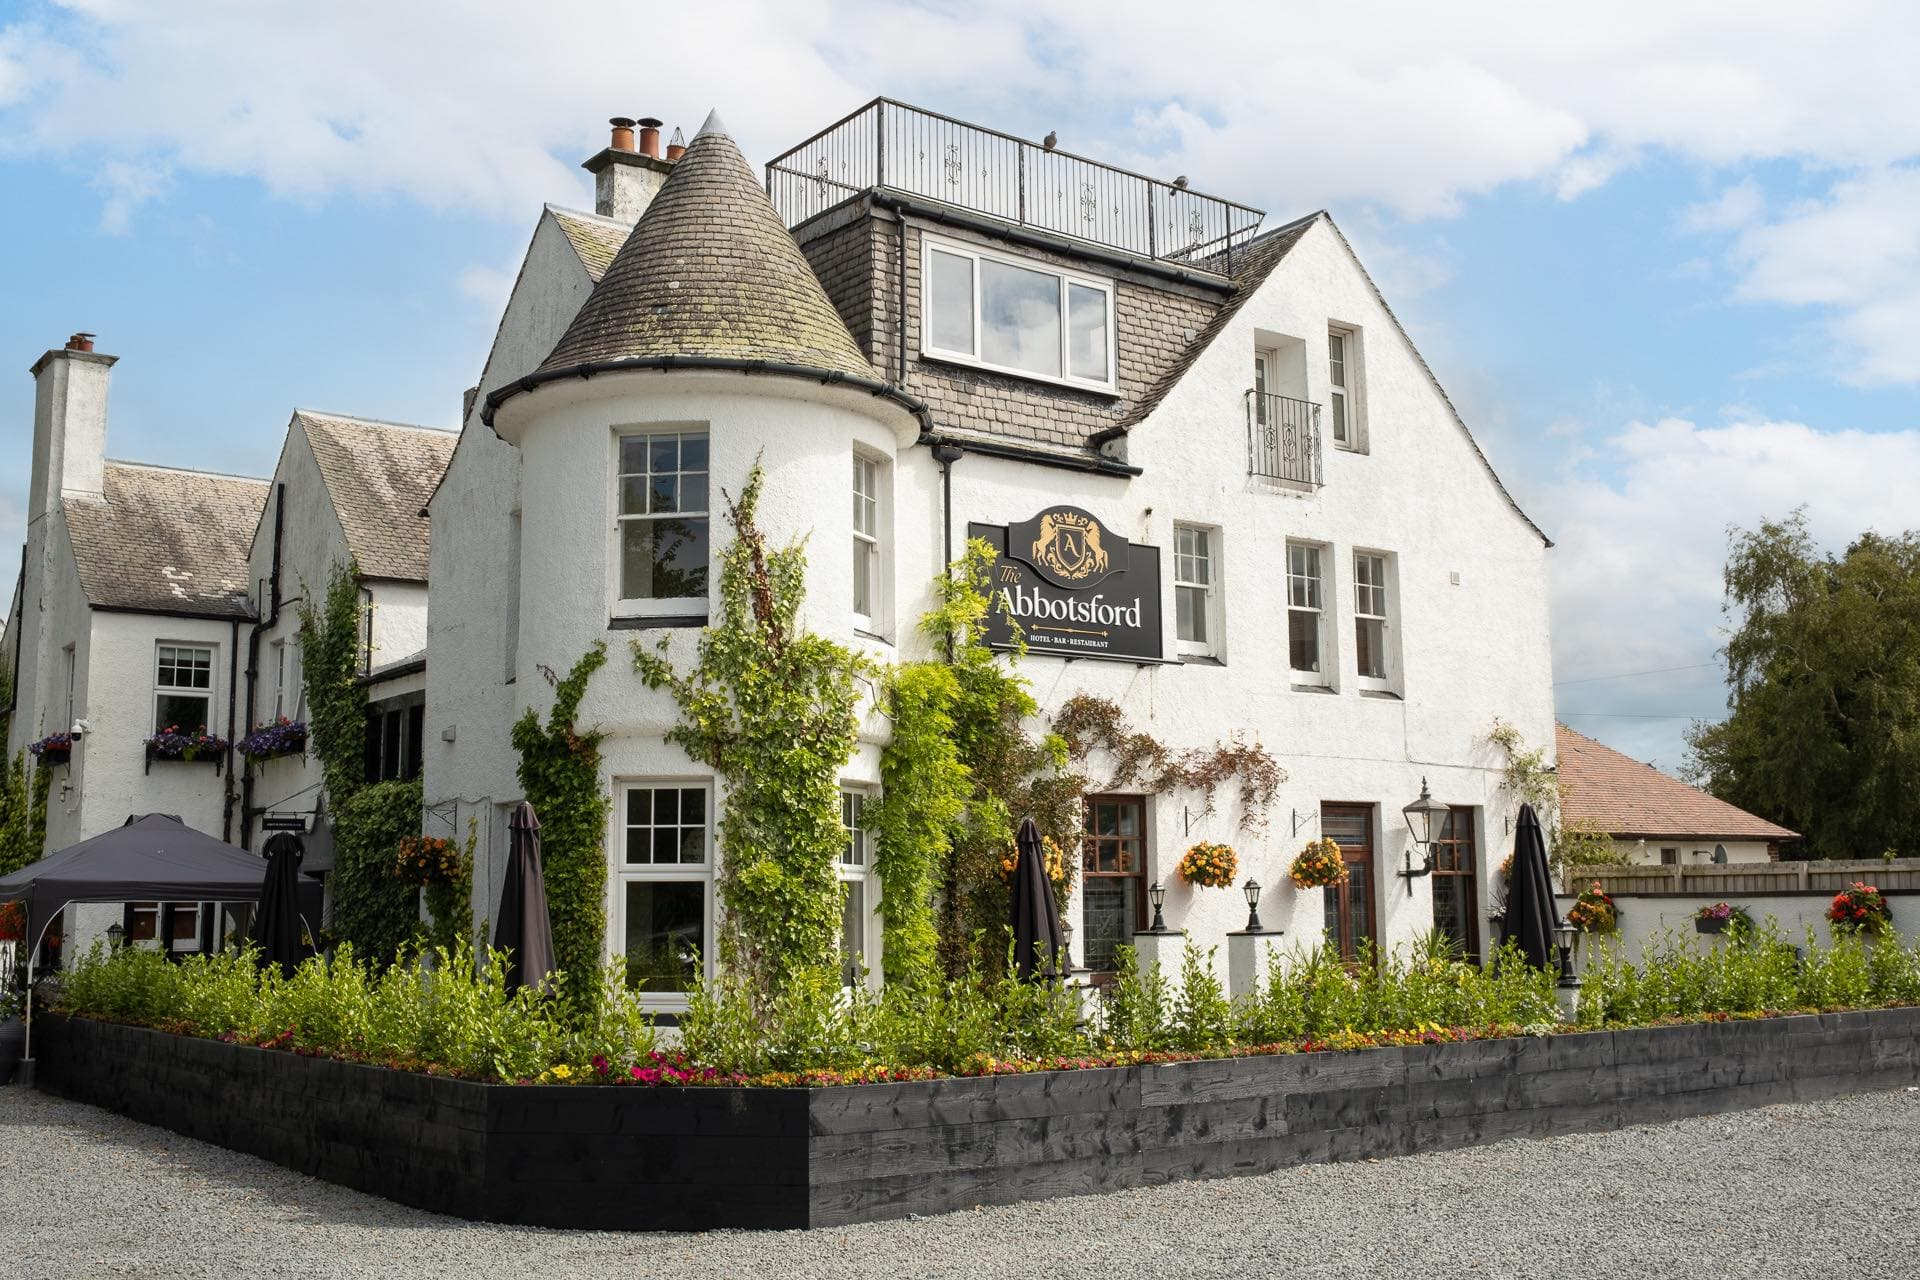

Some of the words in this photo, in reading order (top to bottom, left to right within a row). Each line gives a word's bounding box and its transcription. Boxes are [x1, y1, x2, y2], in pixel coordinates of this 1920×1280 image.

[1064, 533, 1081, 558] A
[1000, 565, 1021, 583] The
[995, 584, 1142, 628] Abbotsford
[1030, 634, 1051, 642] HOTEL
[1054, 636, 1067, 645] BAR
[1069, 638, 1109, 648] RESTAURANT
